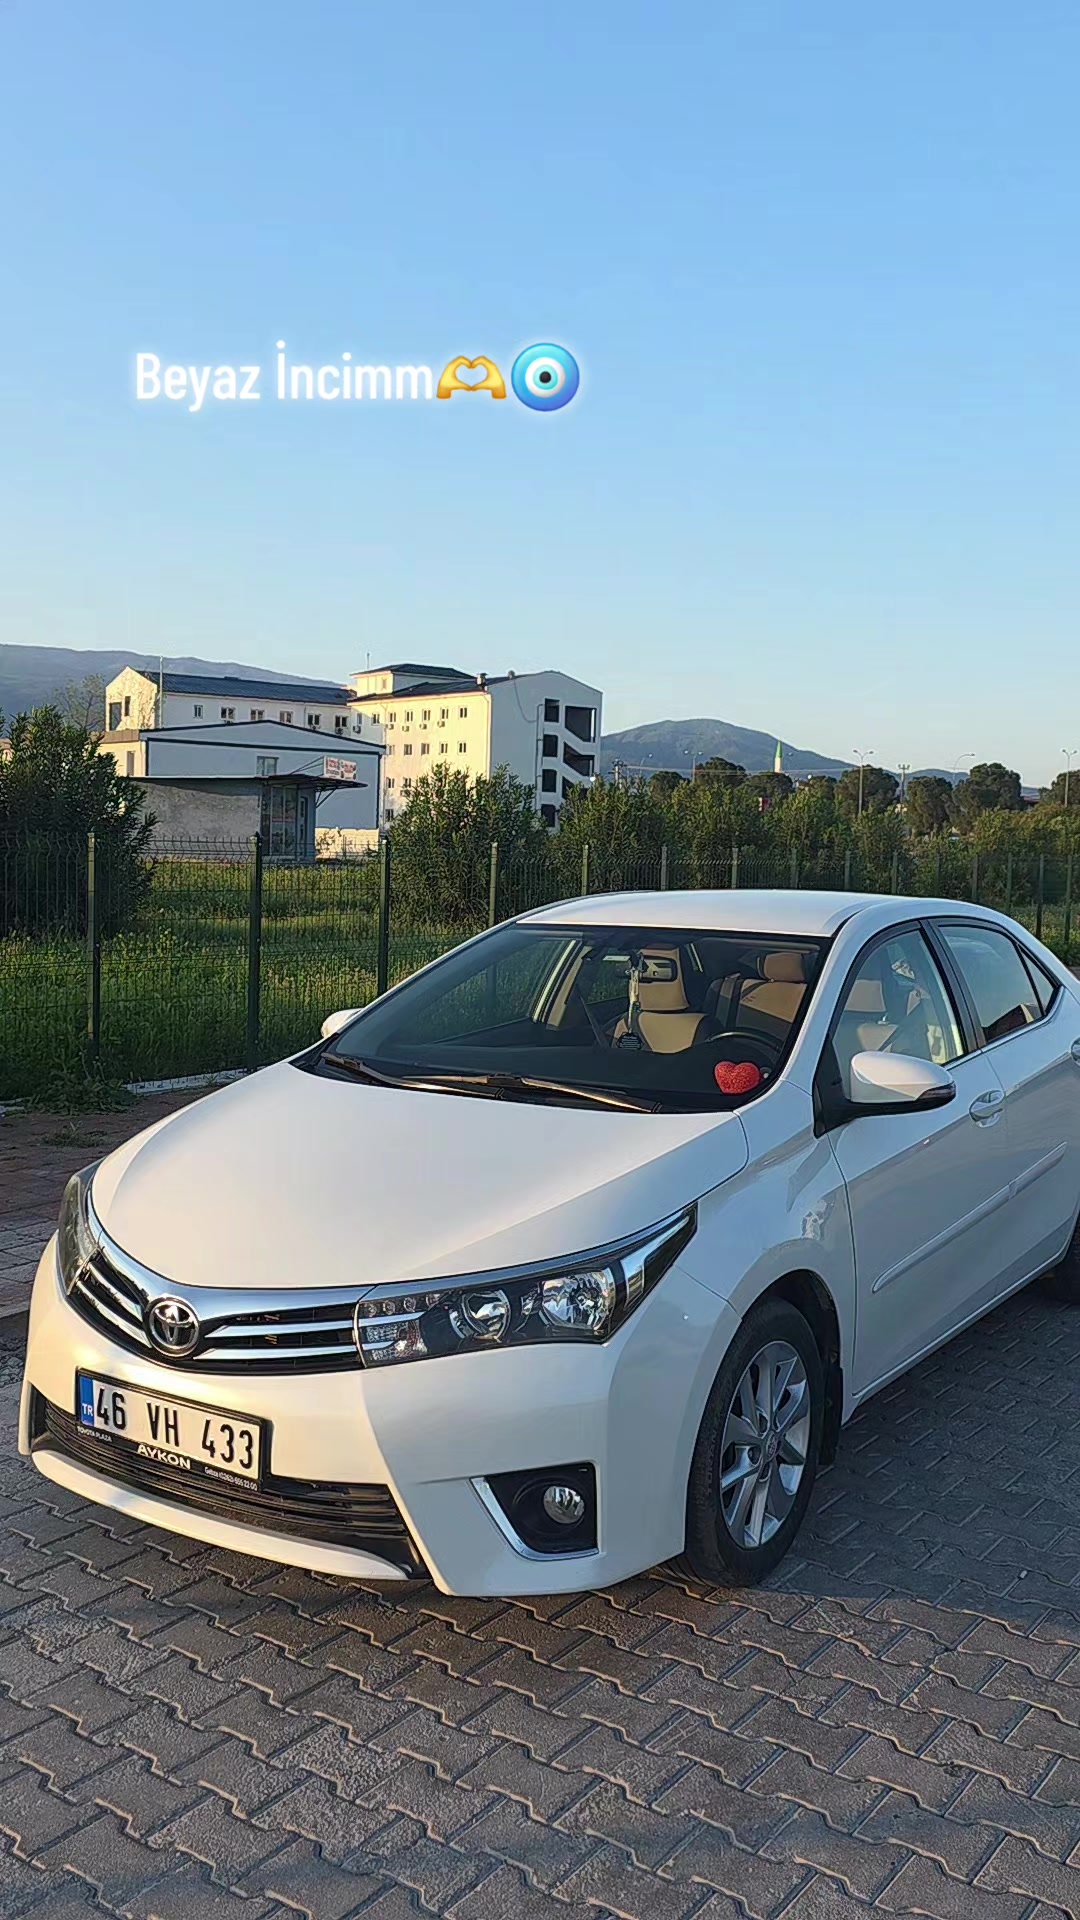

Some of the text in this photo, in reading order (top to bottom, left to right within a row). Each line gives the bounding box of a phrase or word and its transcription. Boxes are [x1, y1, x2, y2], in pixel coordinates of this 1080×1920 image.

[82, 1402, 93, 1416] TR
[96, 1386, 253, 1470] 46 VH 433
[137, 1444, 191, 1470] AYKON
